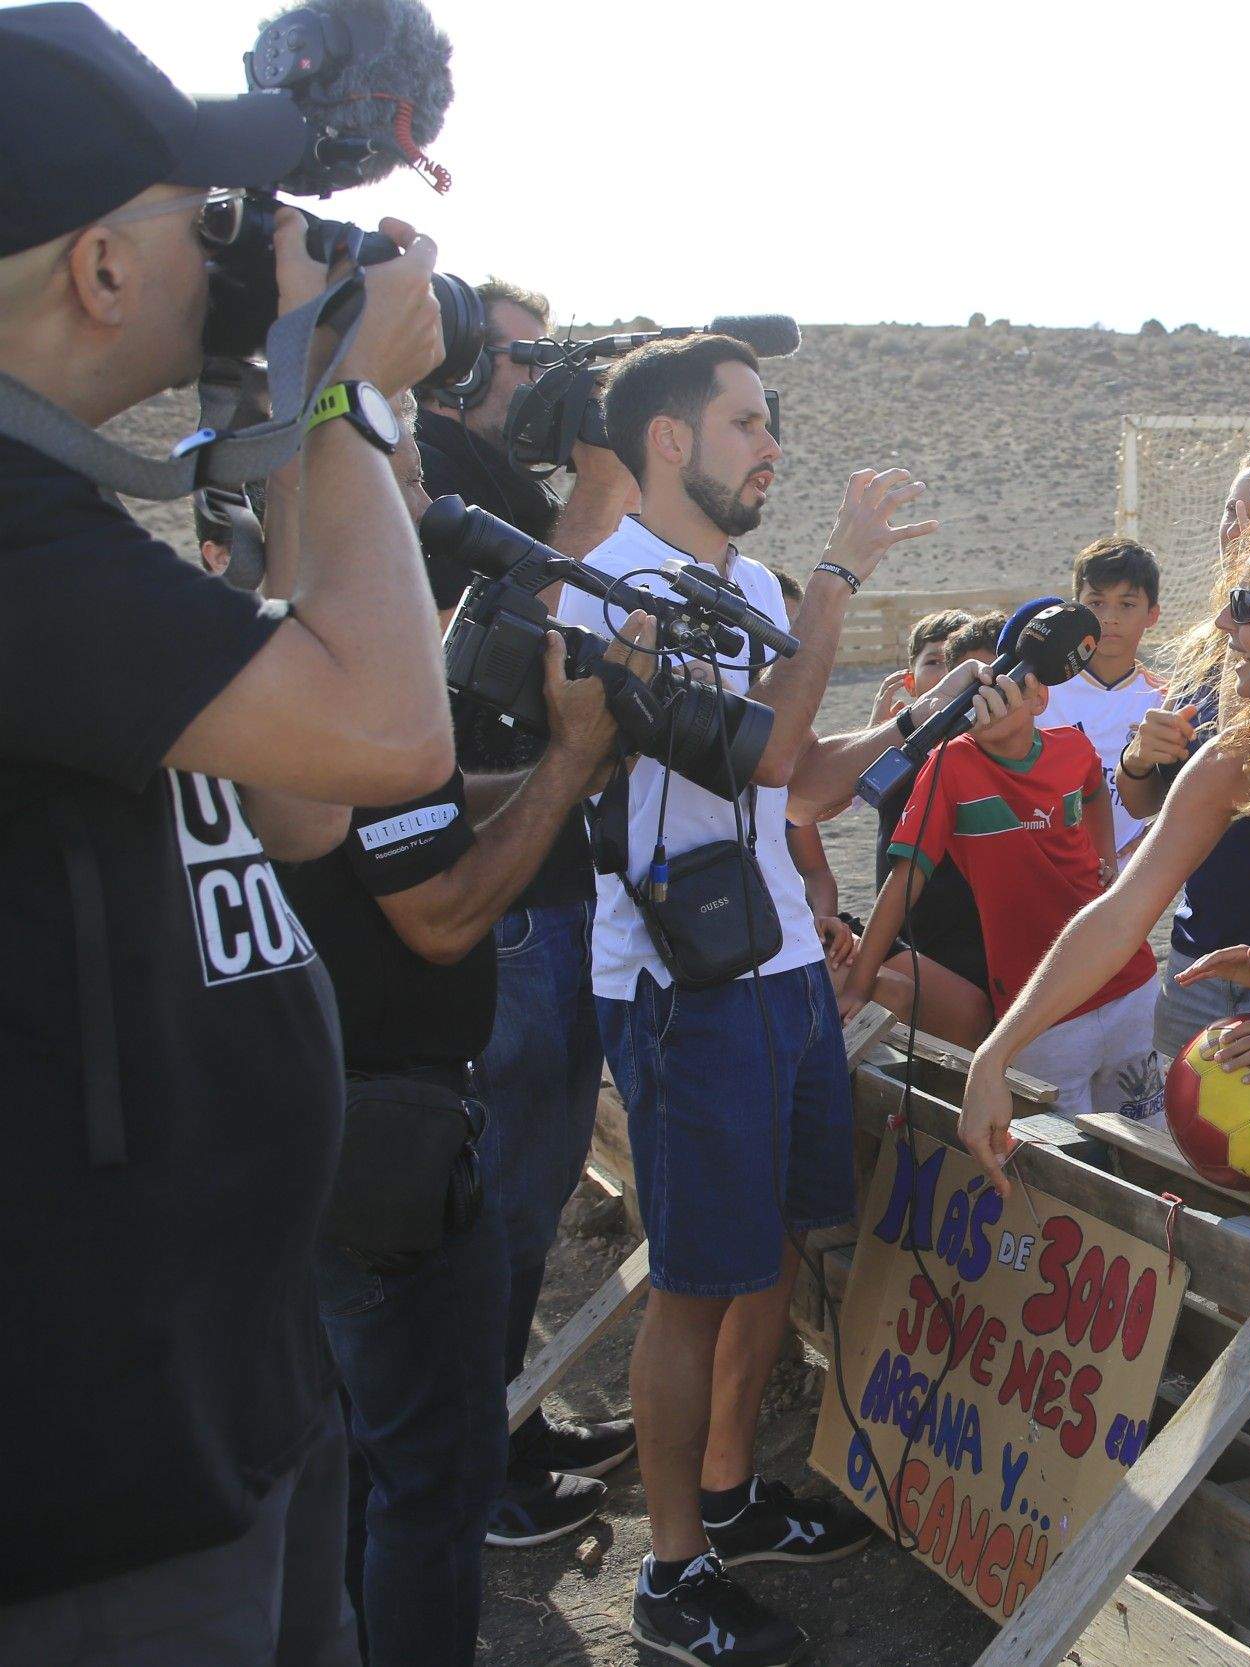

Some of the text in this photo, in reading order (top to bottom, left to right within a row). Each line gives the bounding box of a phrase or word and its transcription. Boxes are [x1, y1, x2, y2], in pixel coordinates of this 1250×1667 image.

[198, 863, 313, 975] CO
[700, 896, 730, 913] GUESS
[998, 1230, 1035, 1271] DE
[1021, 1214, 1158, 1362] 3000
[860, 1348, 983, 1475] ARGANA
[1104, 1413, 1147, 1467] EN
[886, 1459, 1062, 1618] CANCH
